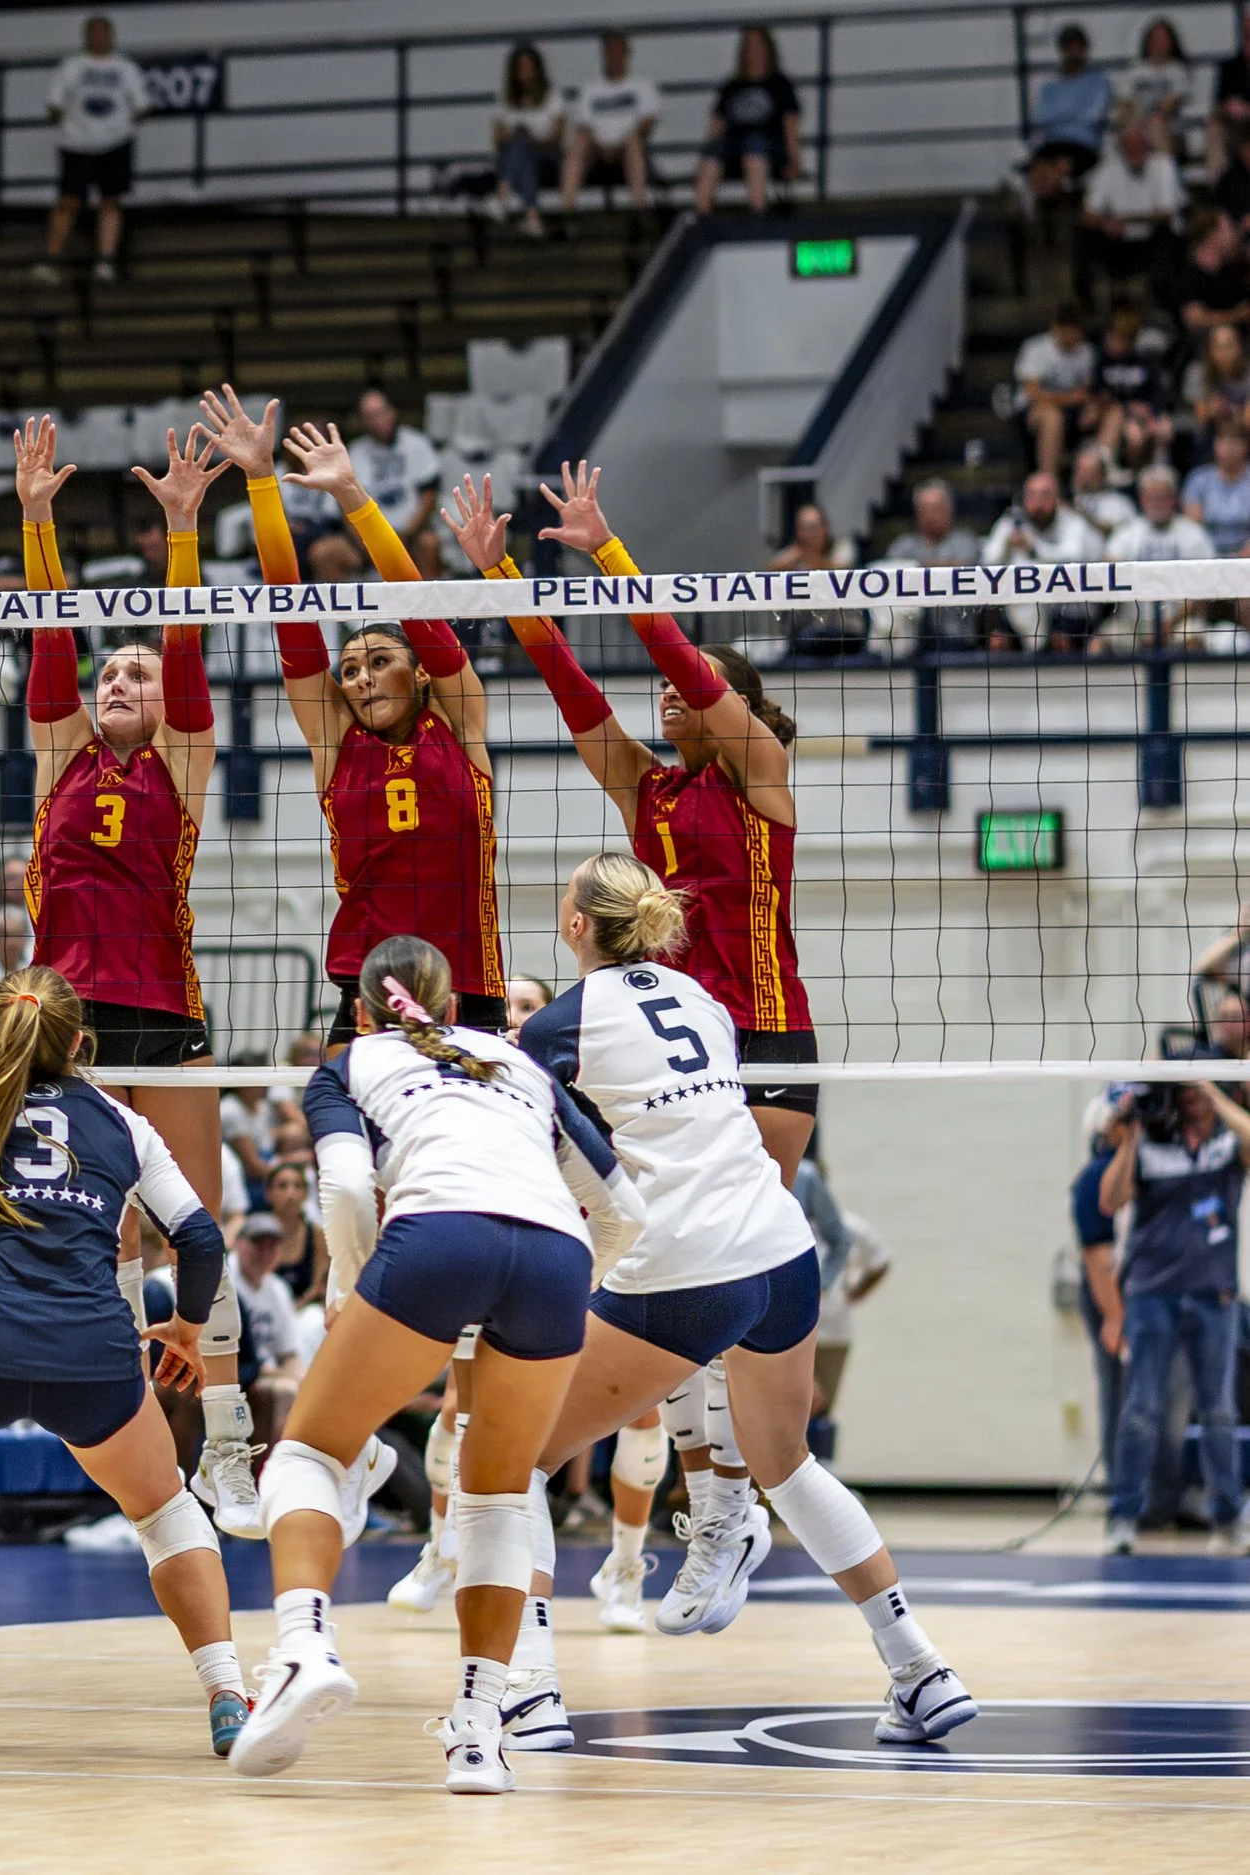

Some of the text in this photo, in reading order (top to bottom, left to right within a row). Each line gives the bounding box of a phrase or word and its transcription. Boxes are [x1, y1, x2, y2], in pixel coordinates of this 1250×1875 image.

[95, 583, 378, 617] VOLLEYBALL
[534, 563, 1132, 606] PENN STATE VOLLEYBALL
[91, 794, 126, 847] 3
[385, 777, 419, 832] 8
[656, 821, 678, 878] 1
[642, 997, 710, 1075] 5
[14, 1106, 69, 1179] 3
